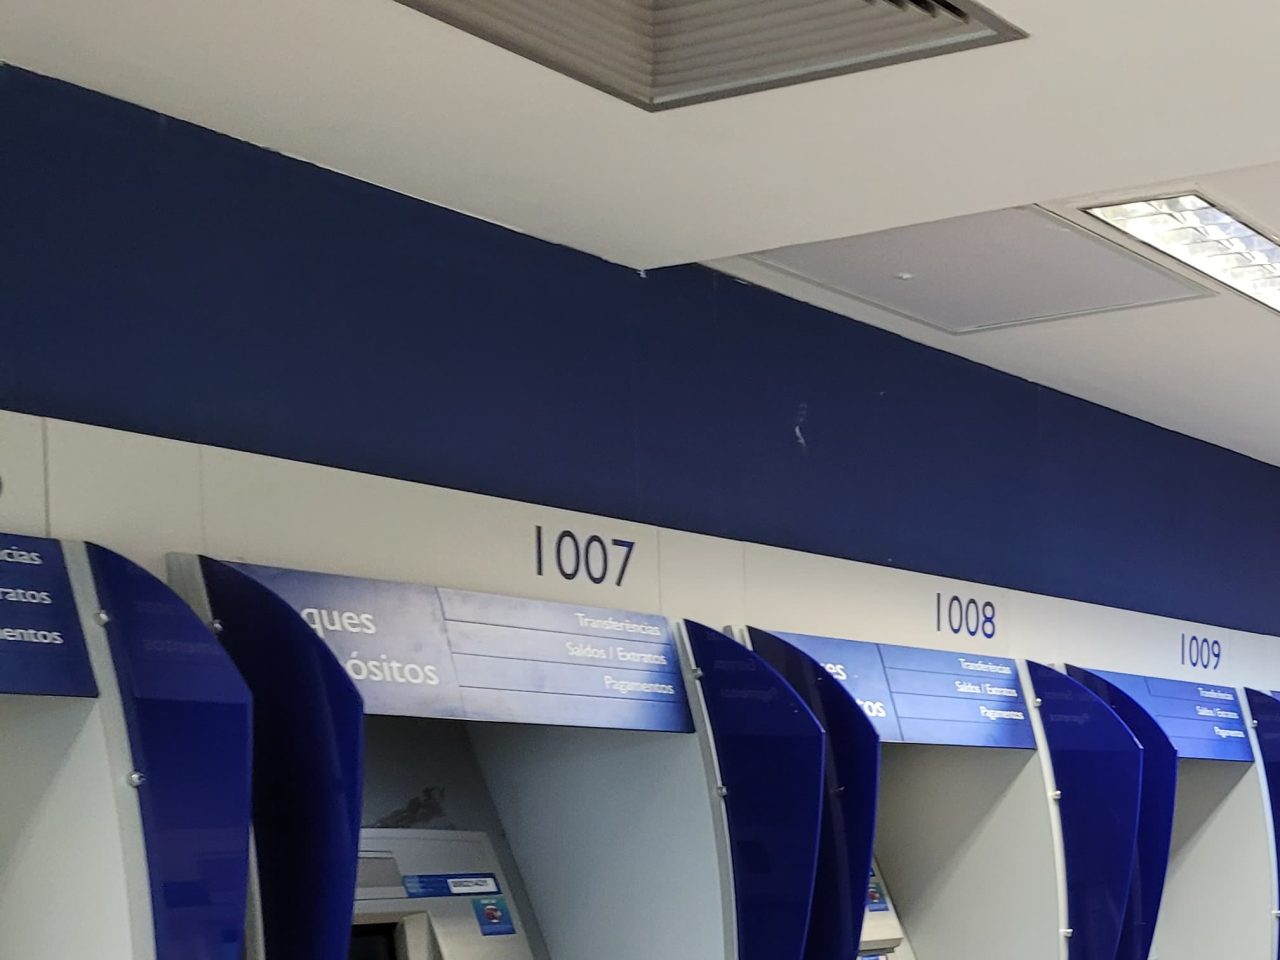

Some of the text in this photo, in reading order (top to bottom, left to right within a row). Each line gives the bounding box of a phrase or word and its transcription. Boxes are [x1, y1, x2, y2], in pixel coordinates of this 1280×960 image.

[534, 525, 636, 587] 1007
[301, 607, 377, 639] ques
[574, 612, 661, 636] Transferências
[936, 592, 996, 639] 1008
[566, 641, 607, 659] Saldos
[616, 646, 668, 665] Extratos
[1181, 632, 1222, 670] 1009
[345, 650, 440, 686] ósitos
[820, 662, 847, 681] es
[603, 675, 675, 695] Pagamentos
[856, 697, 886, 718] os
